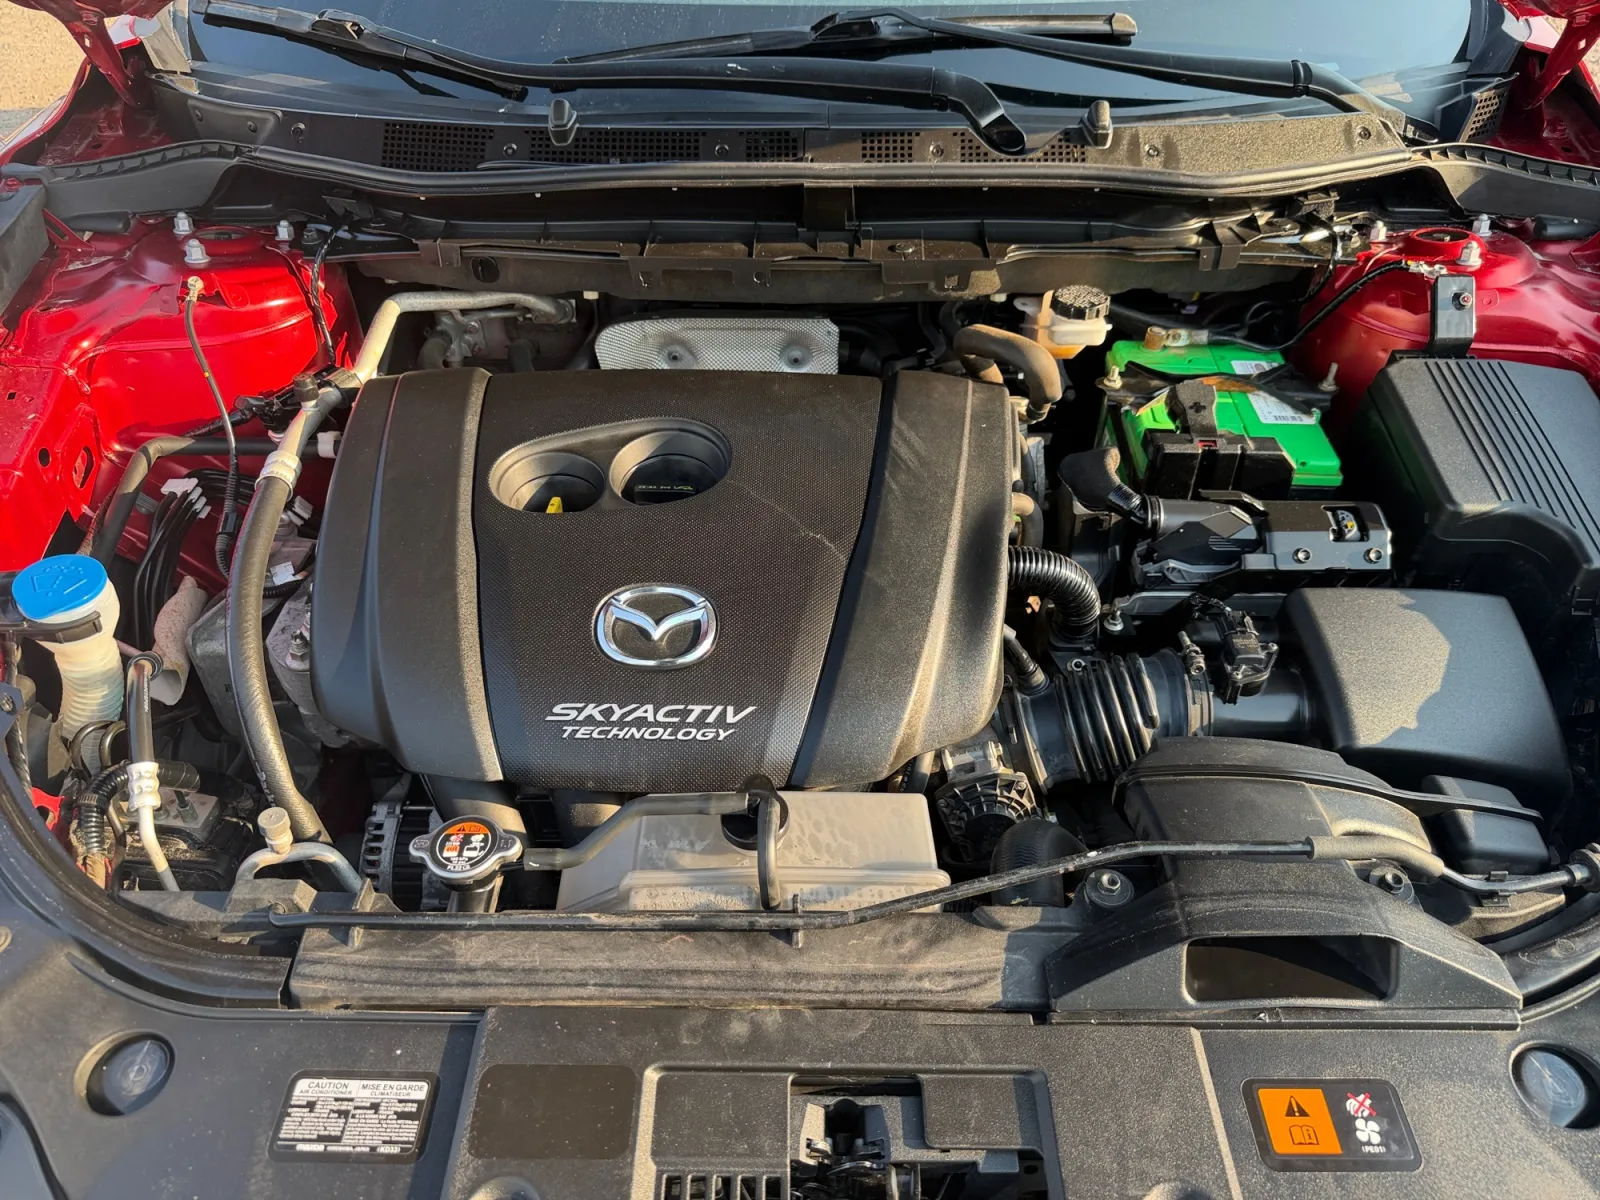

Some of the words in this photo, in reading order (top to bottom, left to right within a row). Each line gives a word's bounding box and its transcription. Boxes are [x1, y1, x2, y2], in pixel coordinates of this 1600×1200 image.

[545, 702, 758, 724] SKYACTIV
[561, 726, 736, 741] TECHNOLOGY
[308, 1081, 349, 1090] CAUTION
[361, 1083, 382, 1091] MISE
[383, 1083, 395, 1091] EN
[396, 1084, 425, 1092] GARDE
